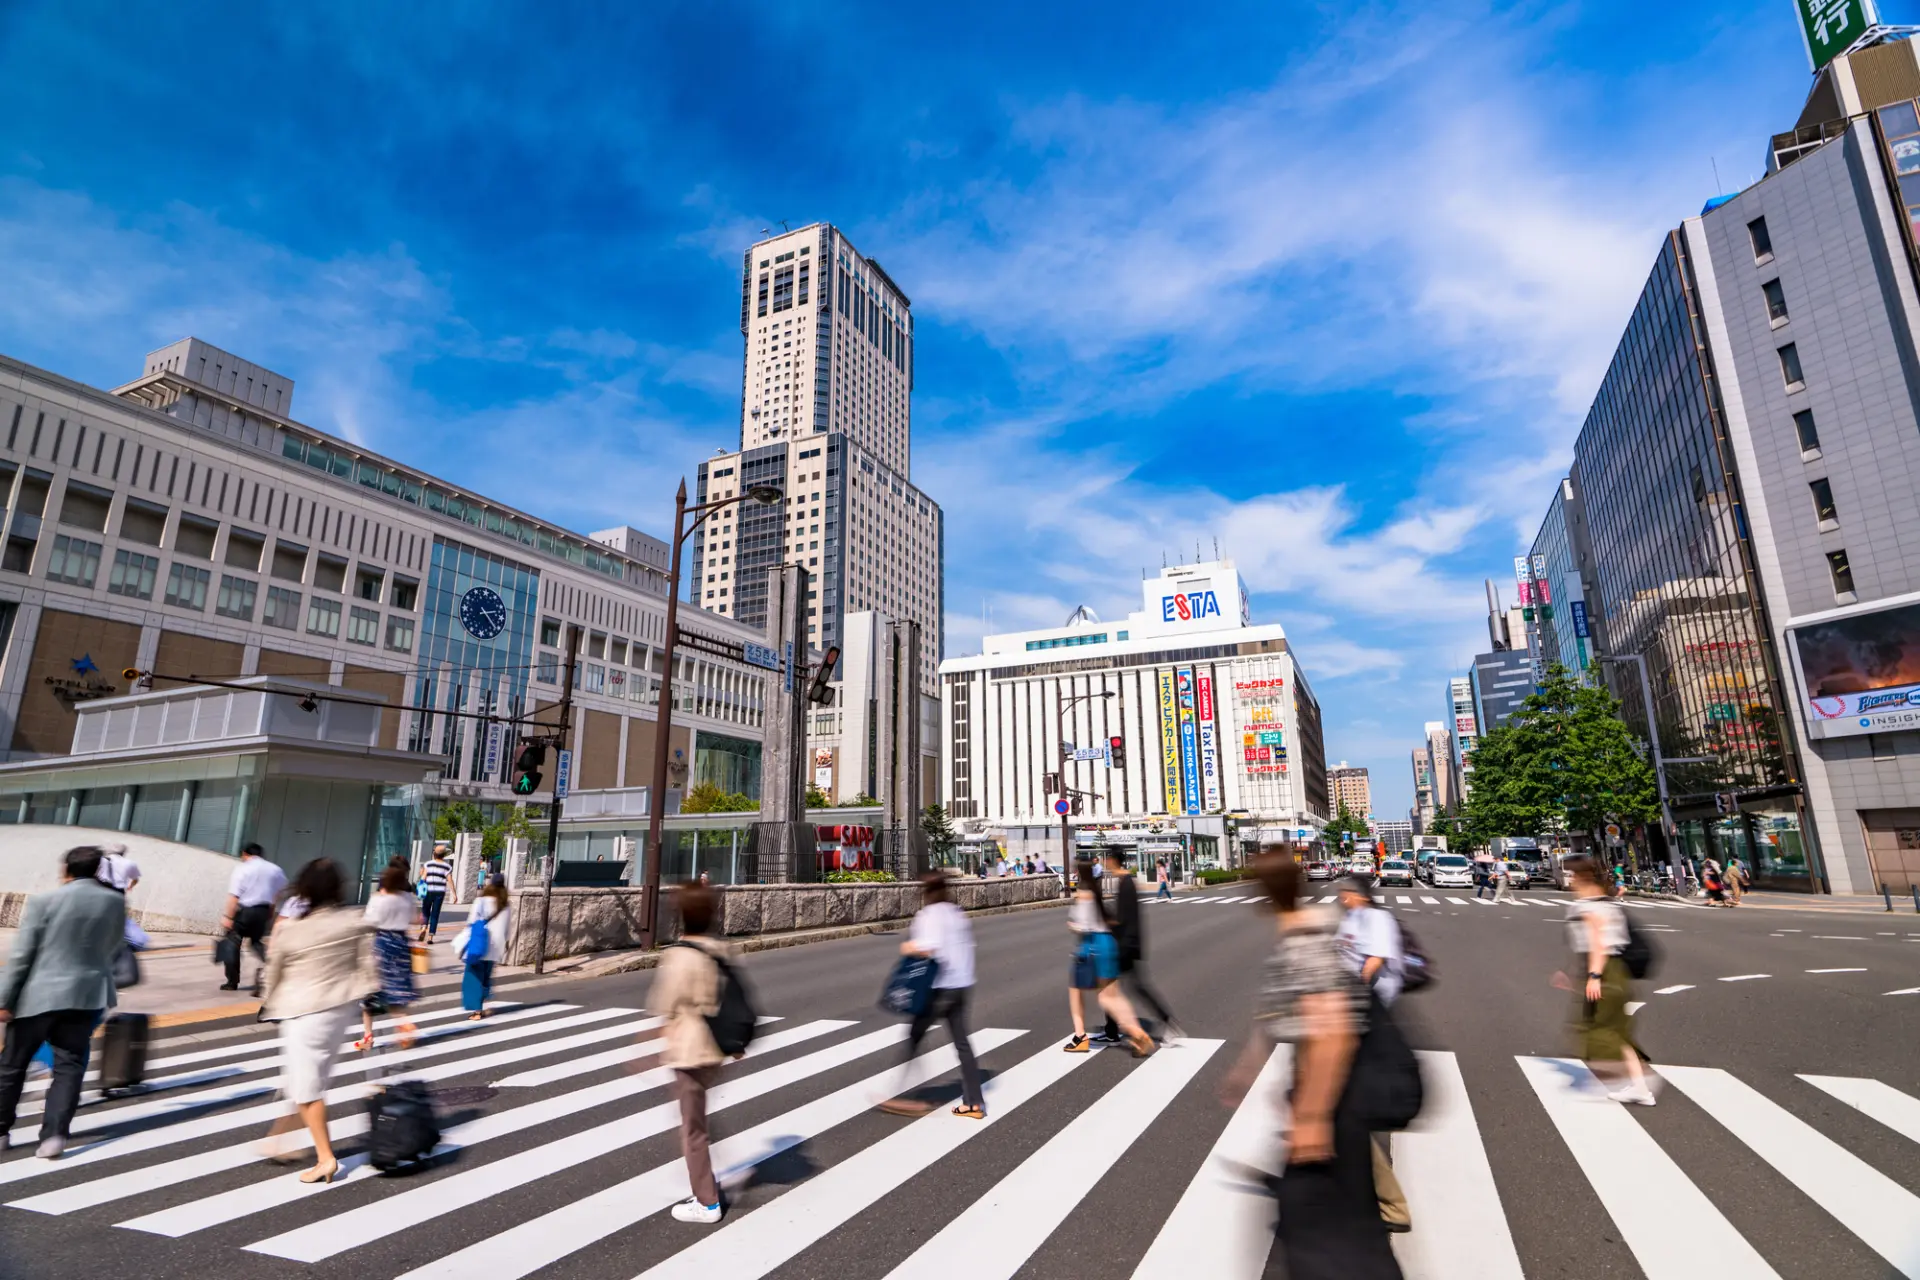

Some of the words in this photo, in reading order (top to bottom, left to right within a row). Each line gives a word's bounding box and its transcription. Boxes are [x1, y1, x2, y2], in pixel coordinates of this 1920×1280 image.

[1162, 591, 1221, 622] ESTA
[45, 676, 116, 692] STELLAR
[1162, 676, 1171, 705] エスタ
[1236, 678, 1283, 690] ビックカメラ
[1202, 690, 1210, 719] CAMERA
[1202, 724, 1213, 746] Tax
[1244, 723, 1282, 731] namco
[1204, 749, 1214, 777] Free
[1247, 764, 1287, 773] ビックカメラ
[842, 825, 875, 848] SAPP
[857, 850, 874, 871] RO
